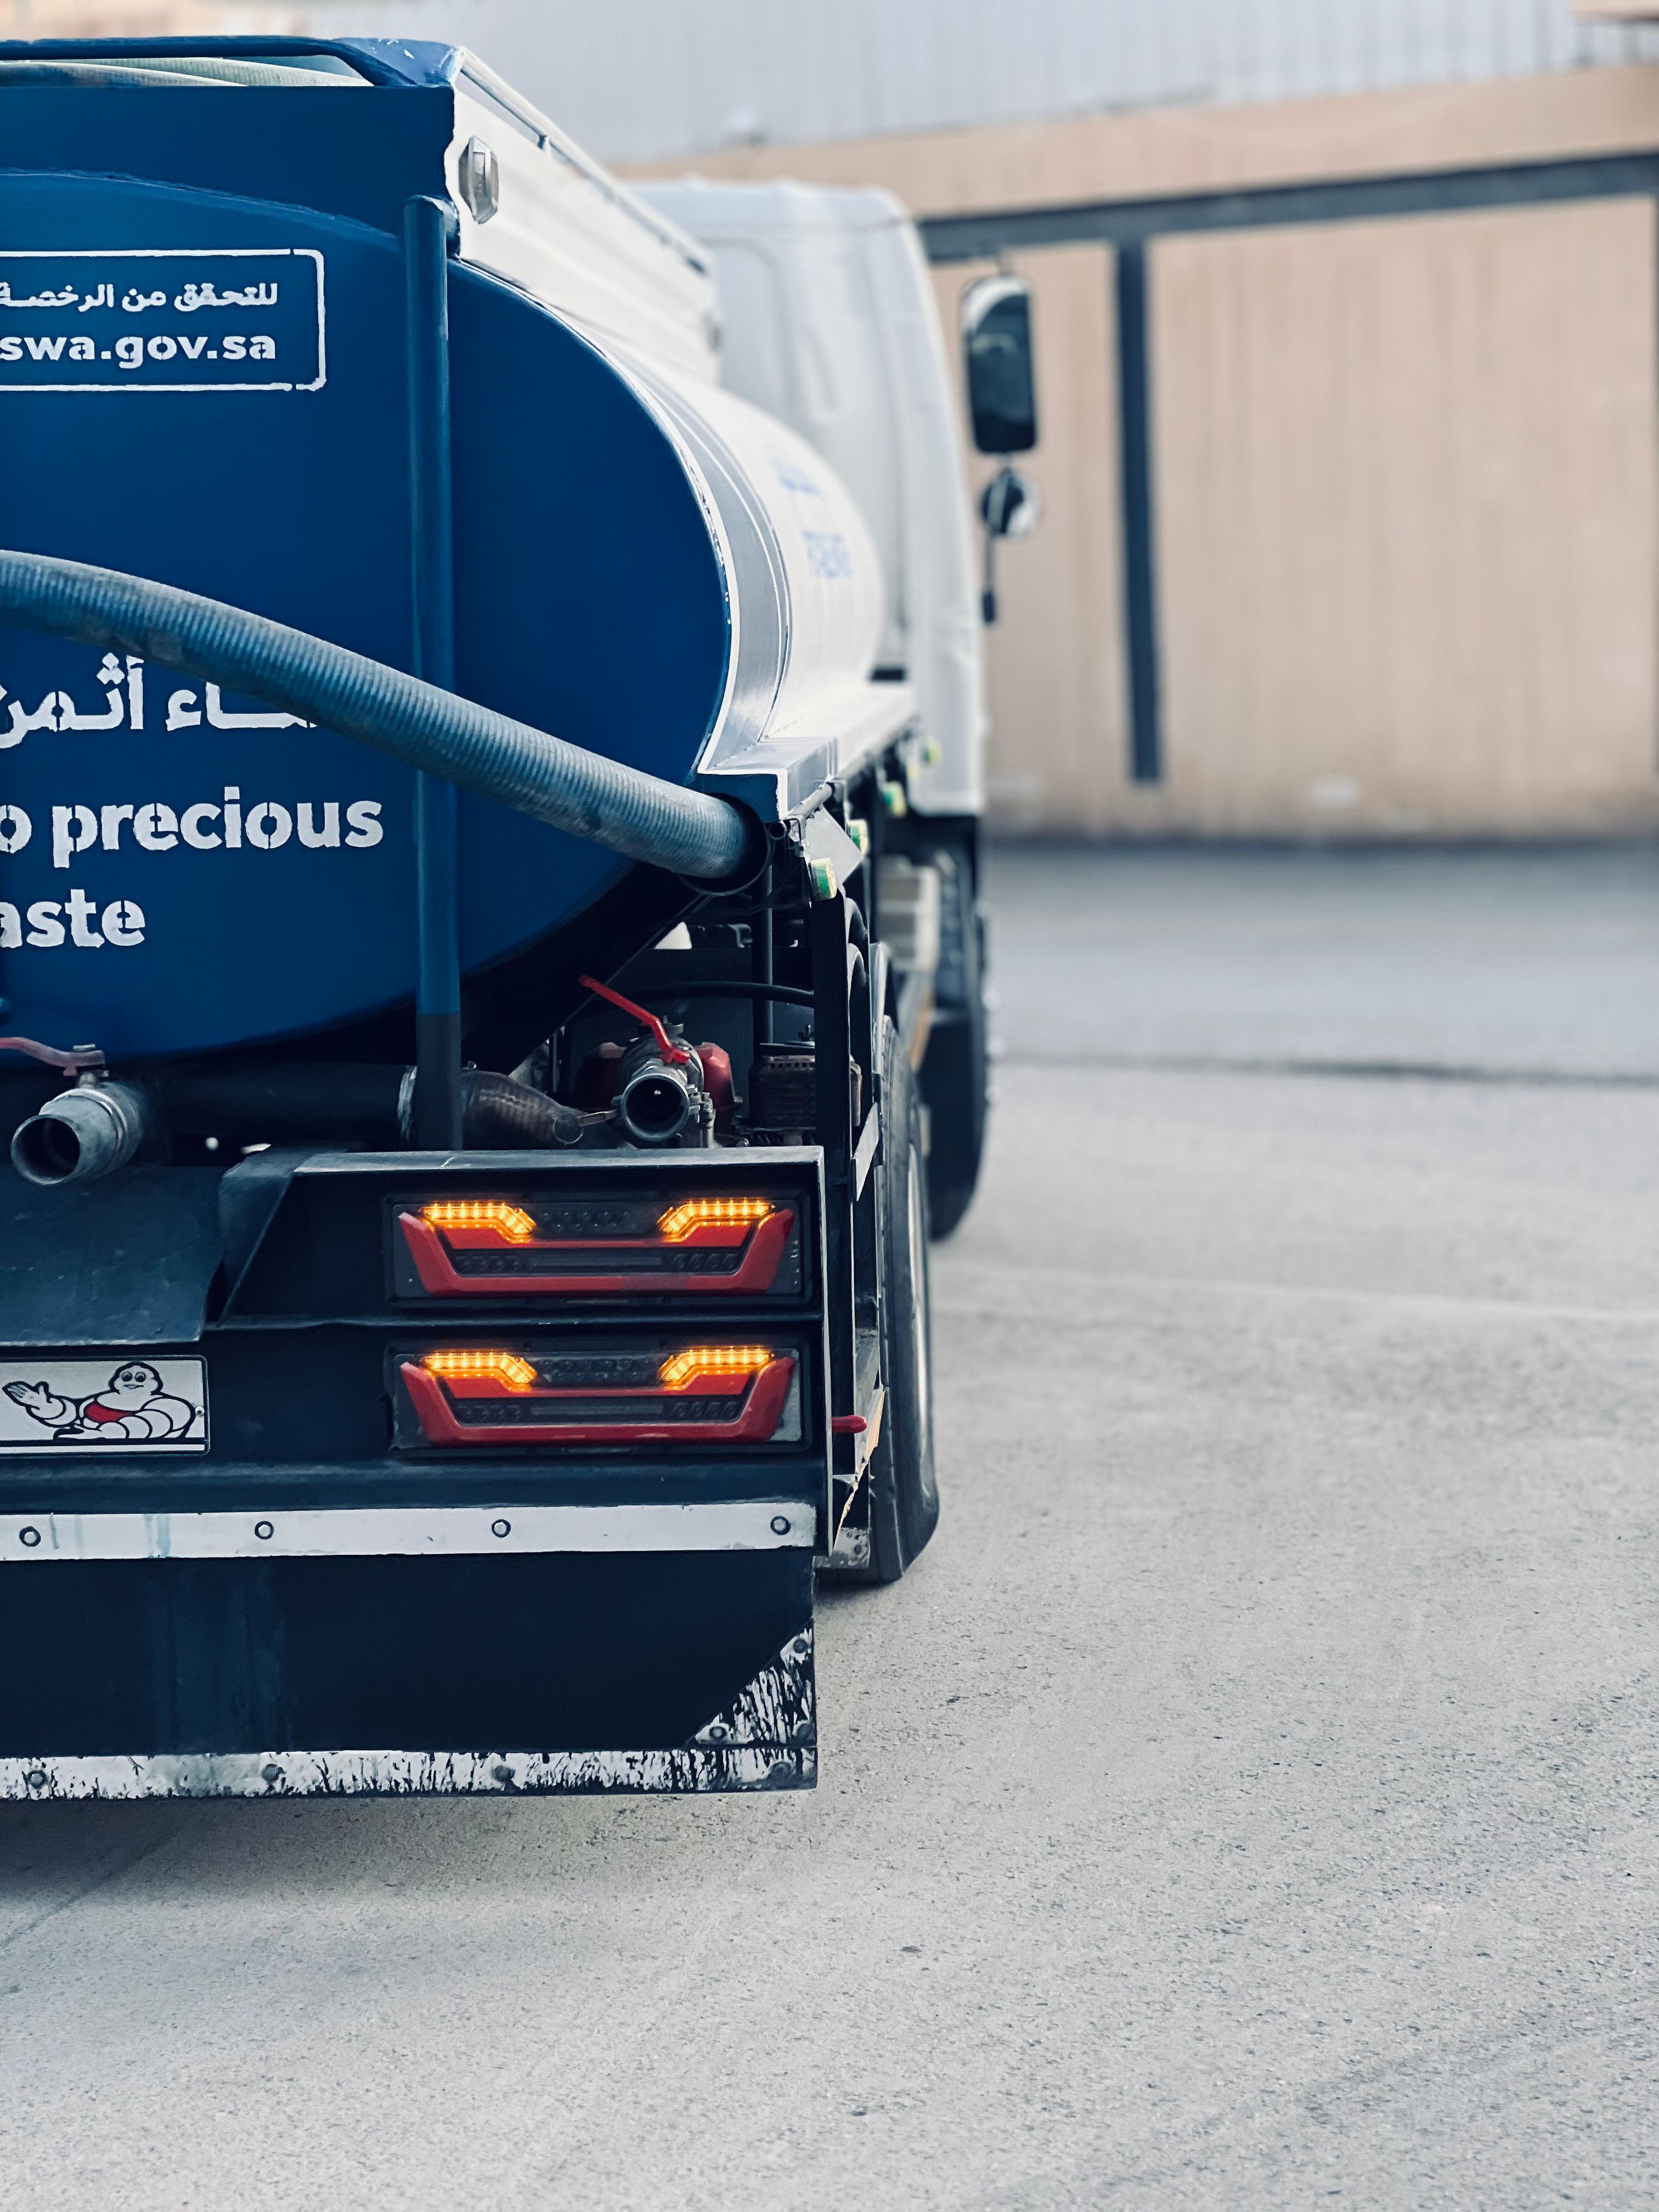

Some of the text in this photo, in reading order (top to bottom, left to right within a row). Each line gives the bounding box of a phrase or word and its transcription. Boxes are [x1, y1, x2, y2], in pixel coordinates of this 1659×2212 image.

[122, 288, 167, 312] من
[174, 282, 278, 312] للتحقق
[0, 335, 275, 369] swa.gov.sa
[52, 786, 383, 868] precious
